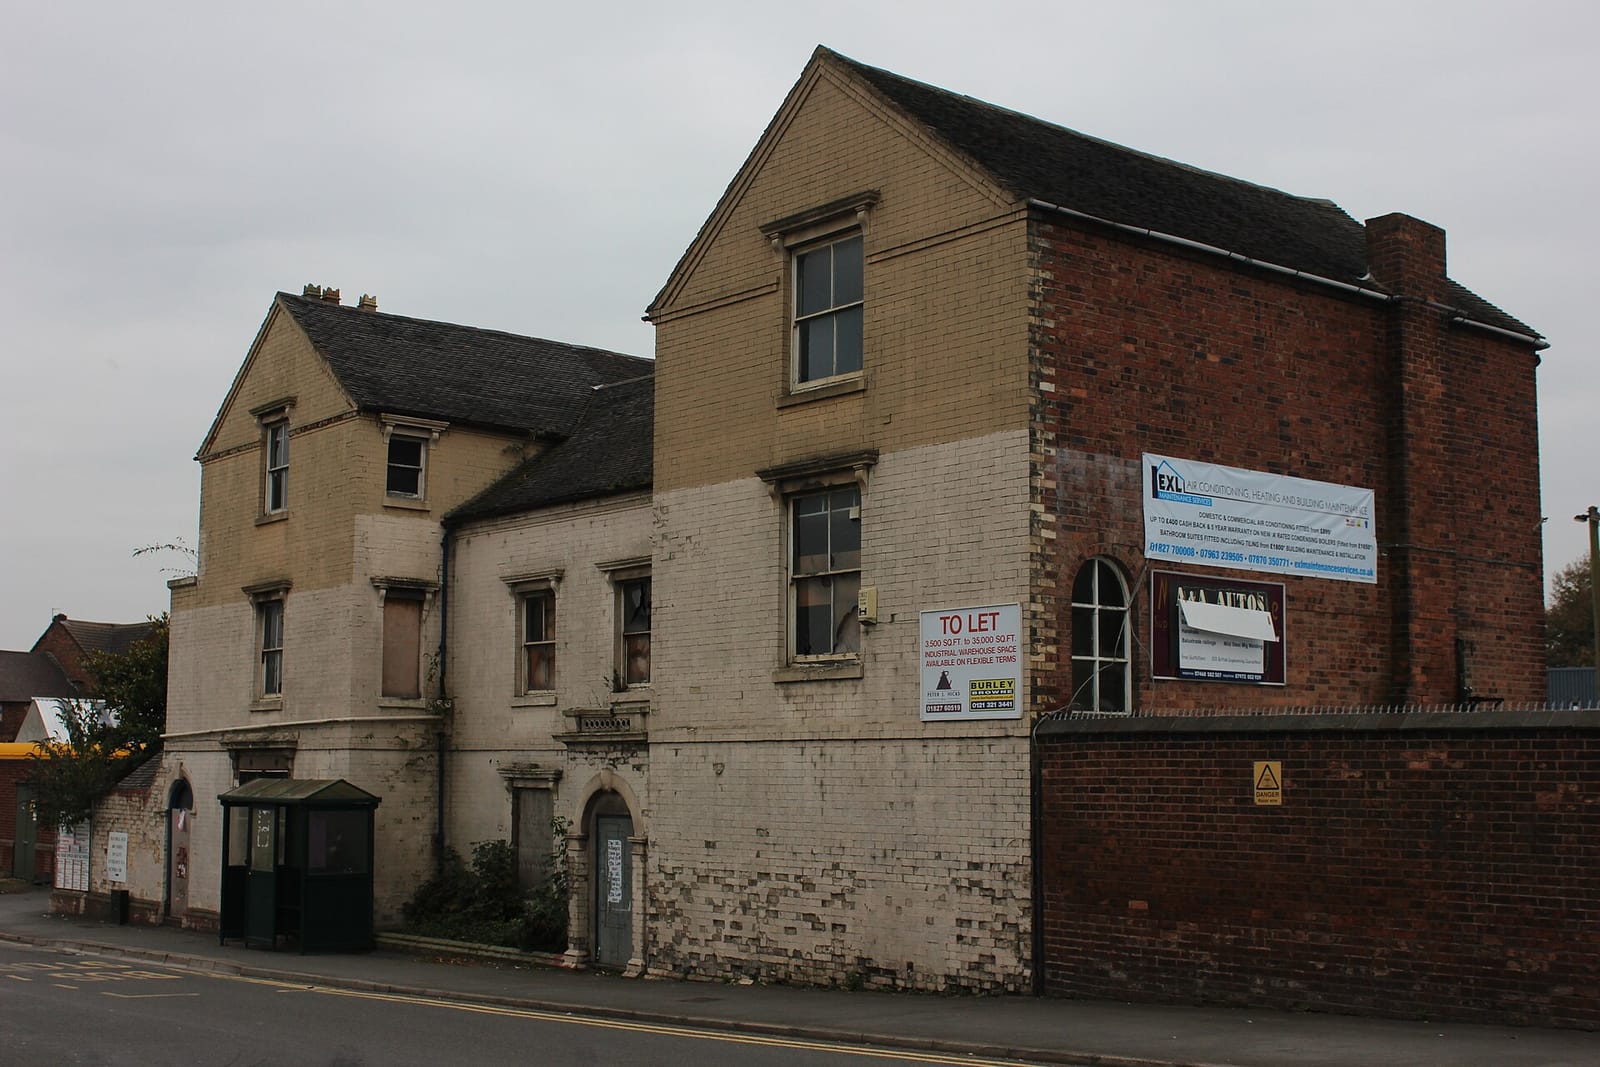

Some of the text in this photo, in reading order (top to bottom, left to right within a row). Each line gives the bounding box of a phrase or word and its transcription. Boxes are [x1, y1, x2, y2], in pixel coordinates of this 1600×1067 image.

[1158, 474, 1182, 493] EXL
[1160, 491, 1192, 502] MAINTENANCE
[1252, 490, 1280, 503] HEATING
[1282, 496, 1295, 504] AND
[1297, 496, 1324, 510] BUILDING
[1199, 512, 1222, 520] DOMESTIC
[1227, 516, 1257, 525] COMMERCIAL
[1265, 520, 1295, 530] CONDITIONING
[1160, 529, 1186, 538] BATHROOM
[1187, 532, 1203, 540] SUITES
[1221, 537, 1245, 546] INCLUDING
[1286, 545, 1305, 554] BUILDING
[1306, 548, 1334, 557] MAINTENANCE
[1339, 552, 1366, 560] INSTALLATION
[1228, 526, 1252, 535] WARRANTY
[1291, 534, 1318, 543] CONDENSING
[1319, 537, 1336, 546] BOILERS
[1150, 542, 1373, 576] 01827 700008 07963 239505 07870 350771 exlmaintenanceservices.co.uk
[1217, 591, 1265, 611] AUTOS
[940, 612, 999, 634] TO LET
[926, 659, 955, 667] AVAILABLE
[967, 656, 994, 665] FLEXIBLE
[971, 681, 1013, 689] BURLEY
